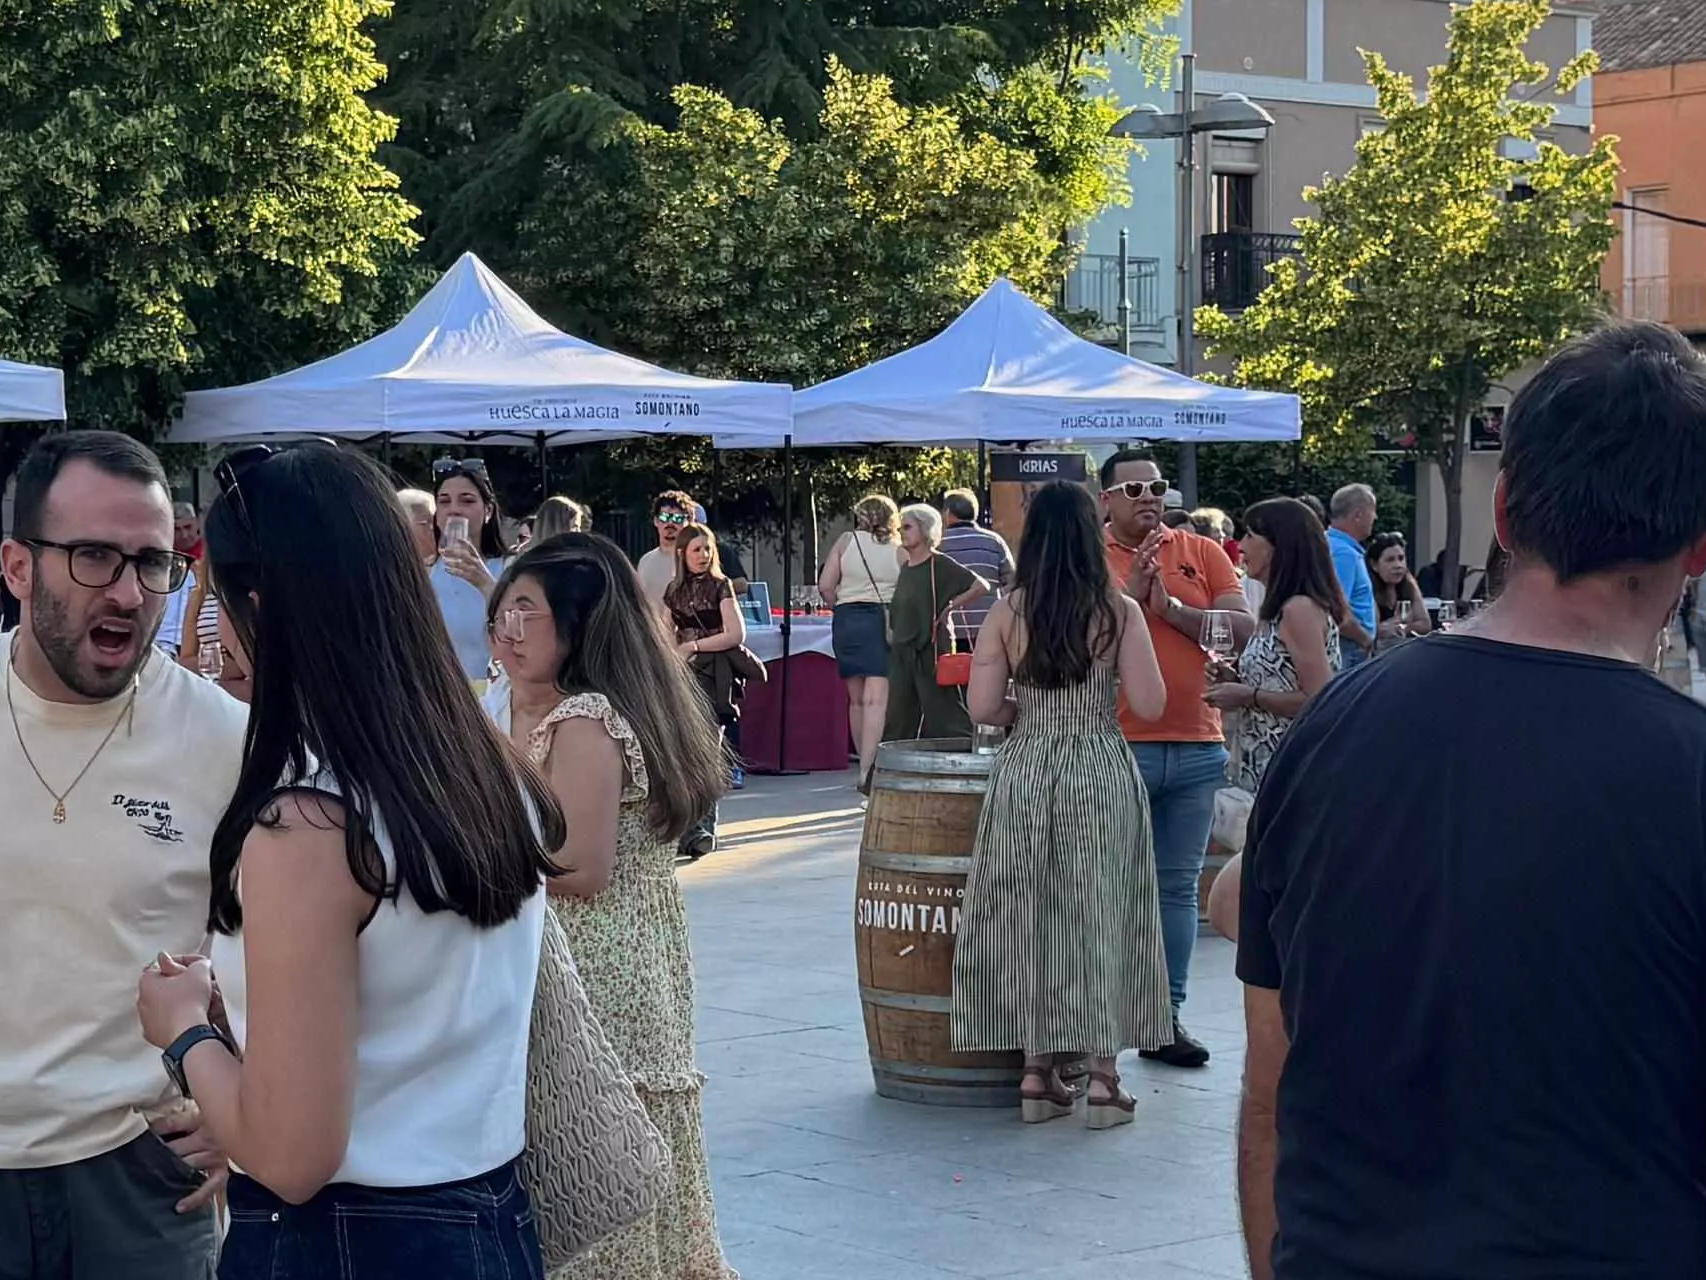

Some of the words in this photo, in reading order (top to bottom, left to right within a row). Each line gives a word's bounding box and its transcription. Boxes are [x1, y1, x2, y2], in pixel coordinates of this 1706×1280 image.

[635, 401, 700, 417] SOMONTANO
[896, 884, 918, 895] DEL
[926, 886, 965, 898] VINO
[857, 897, 964, 934] SOMONTAN
